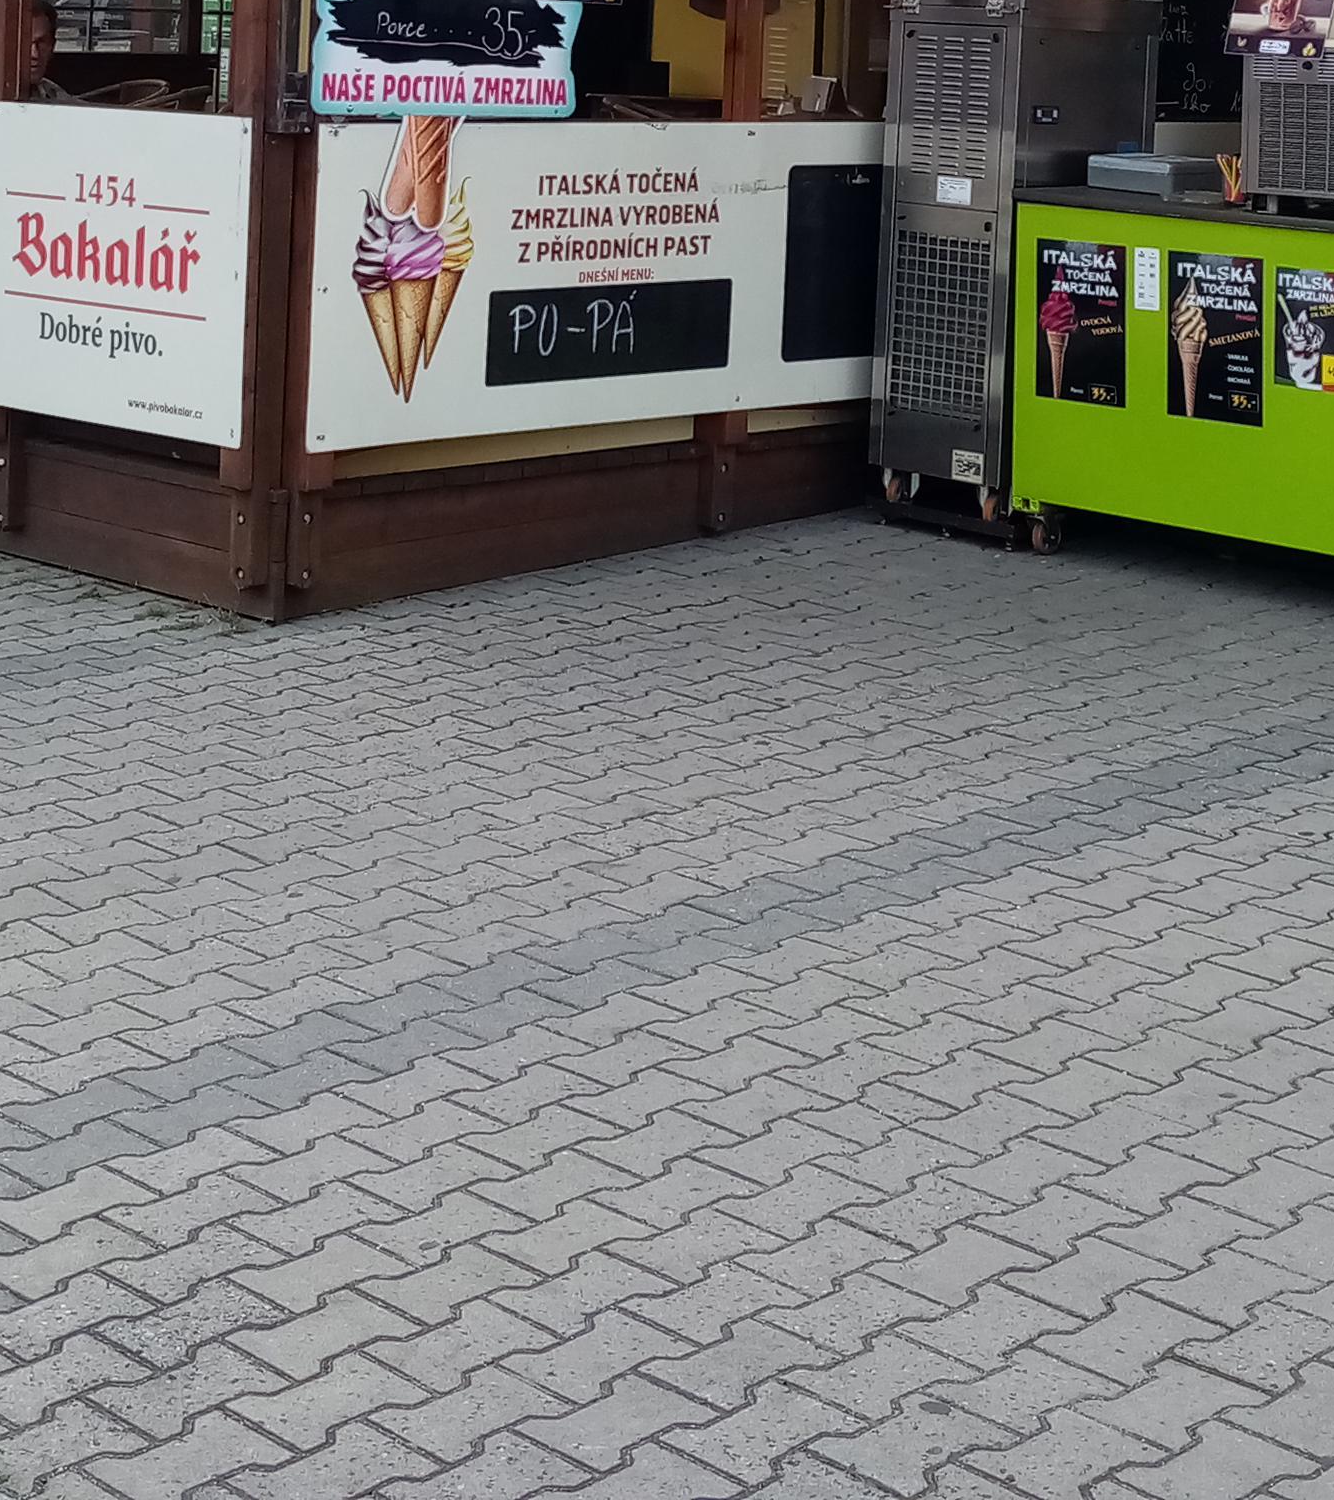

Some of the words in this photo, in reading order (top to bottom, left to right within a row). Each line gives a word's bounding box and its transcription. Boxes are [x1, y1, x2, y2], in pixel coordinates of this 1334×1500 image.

[322, 68, 375, 101] NAŠE
[382, 71, 466, 104] POCTIVÁ
[472, 76, 567, 106] ZMRZLINA
[74, 173, 137, 208] 1454
[538, 168, 620, 197] ITALSKÁ
[626, 167, 699, 194] TOČENÁ
[511, 207, 614, 230] ZMRZLINA
[619, 197, 720, 227] VYROBENÁ
[12, 212, 200, 294] Bakalář
[518, 242, 531, 263] Z
[536, 232, 658, 263] PŘÍRODNÍCH
[663, 235, 712, 257] PAST
[1043, 249, 1117, 270] ITALSKÁ
[578, 267, 619, 284] DNEŠNÍ
[621, 267, 655, 281] MENU:
[1066, 268, 1112, 283] TOČENÁ
[1177, 262, 1257, 285] ITALSKÁ
[1051, 280, 1119, 298] ZMRZLINA
[1201, 281, 1251, 298] TOČENÁ
[1185, 294, 1258, 313] ZMRZLINA
[39, 312, 103, 348] Dobré
[109, 321, 164, 359] pivo.
